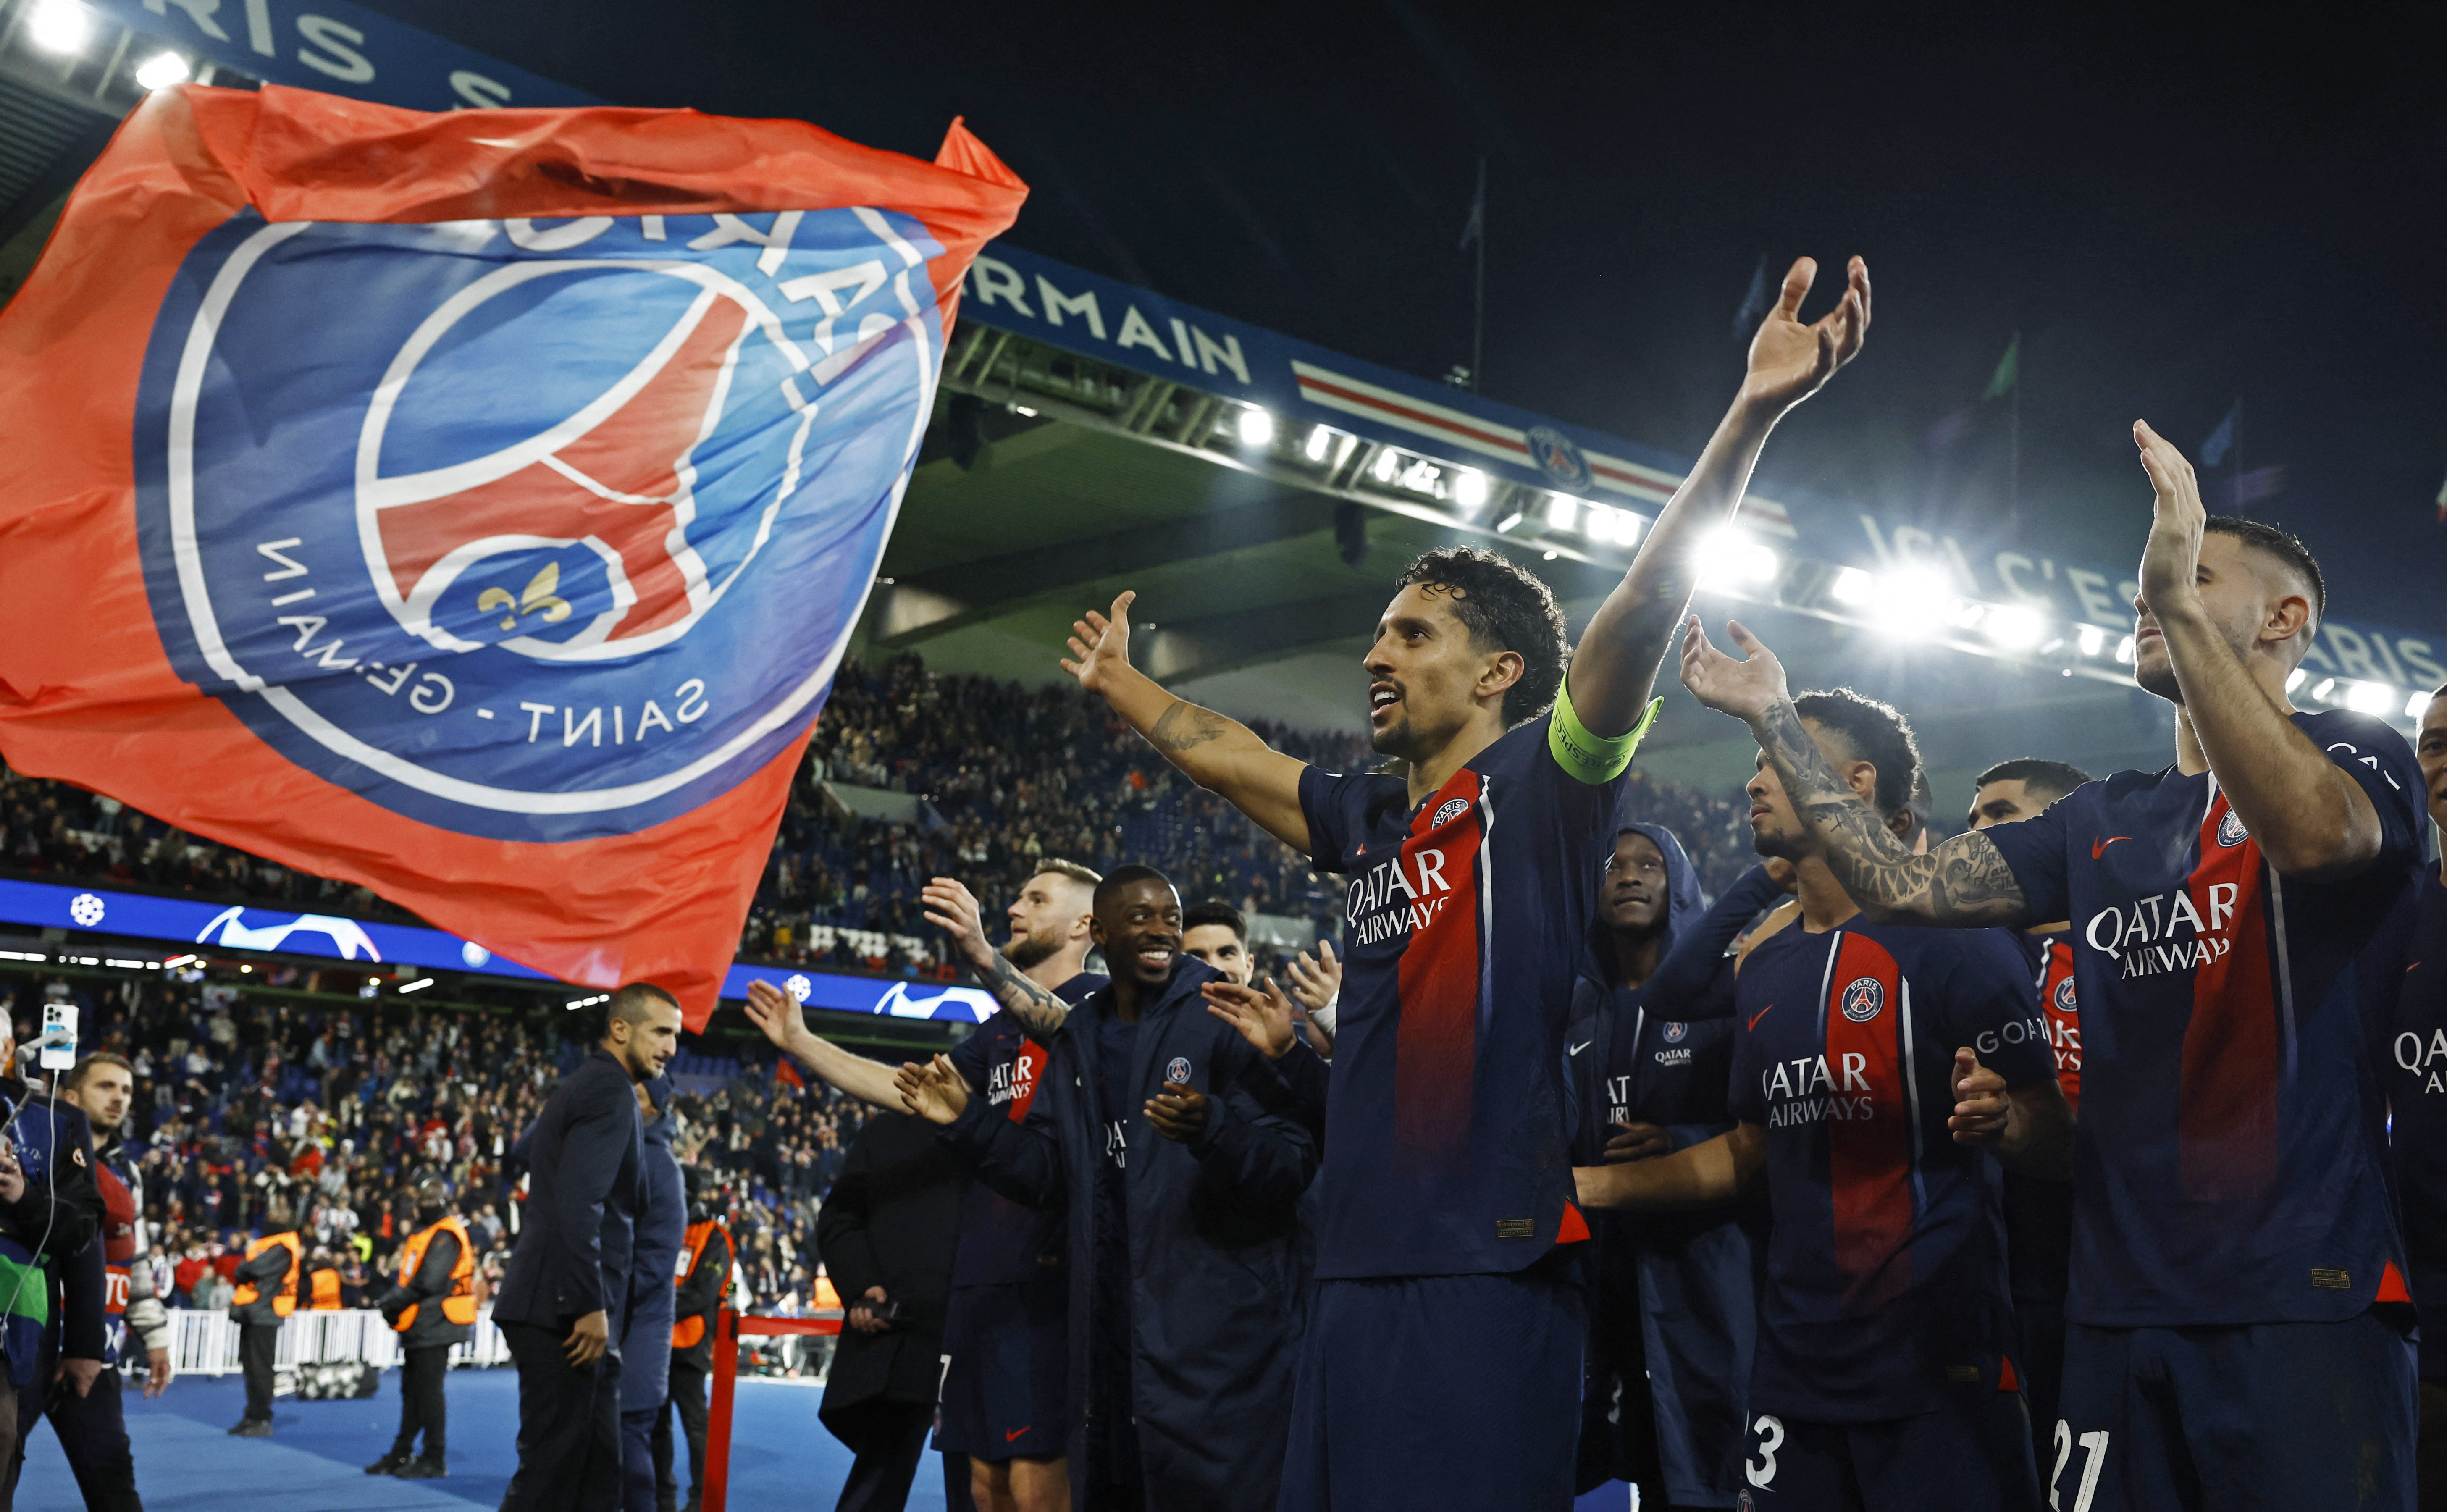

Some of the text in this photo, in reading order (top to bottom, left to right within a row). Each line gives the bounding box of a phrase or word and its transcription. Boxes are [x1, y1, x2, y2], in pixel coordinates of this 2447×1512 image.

[963, 254, 1252, 385] RMAIN
[1435, 801, 1461, 824] PARIS
[1347, 849, 1452, 929] QATAR
[2086, 883, 2239, 960] QATAR
[1851, 979, 1878, 991] PARIS
[1655, 1048, 1691, 1063] QATAR
[1762, 1053, 1872, 1101] ATAR
[1769, 1096, 1874, 1129] AIRWAYS
[2049, 1419, 2110, 1512] 21
